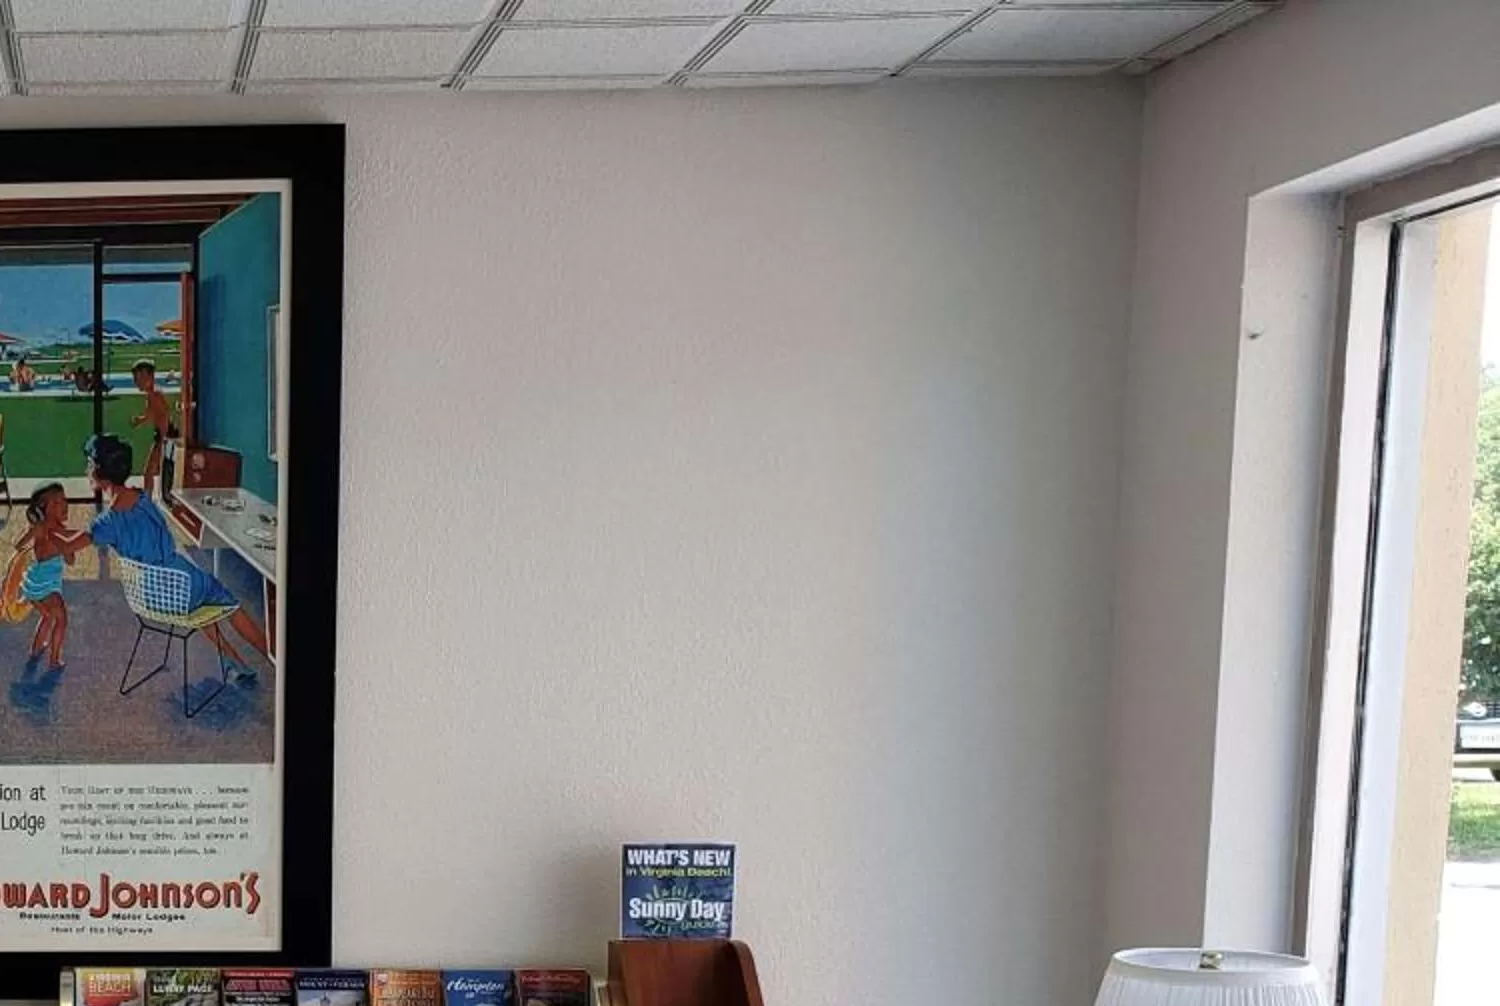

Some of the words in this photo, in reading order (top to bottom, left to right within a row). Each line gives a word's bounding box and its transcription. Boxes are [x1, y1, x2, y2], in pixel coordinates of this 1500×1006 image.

[29, 785, 47, 802] at
[1, 812, 45, 836] Lodge
[627, 849, 689, 866] WHAT'S
[693, 849, 731, 866] NEW
[640, 867, 684, 878] Virginia
[89, 872, 261, 918] JOHNSON'S
[111, 911, 141, 921] Motor
[145, 911, 186, 921] Lodges
[628, 897, 687, 920] Sunny
[690, 899, 725, 921] Day
[88, 981, 132, 993] BEACH
